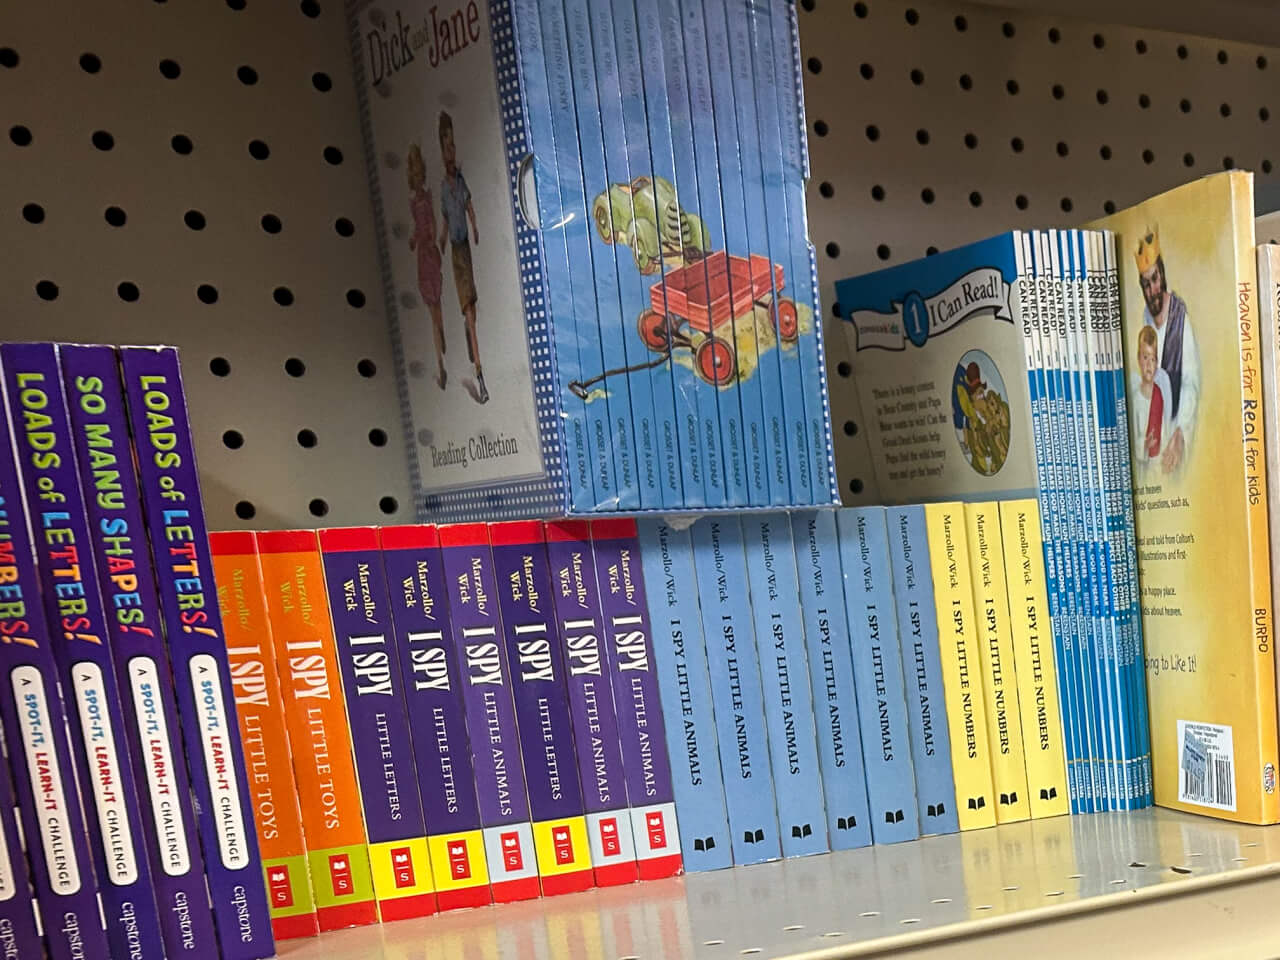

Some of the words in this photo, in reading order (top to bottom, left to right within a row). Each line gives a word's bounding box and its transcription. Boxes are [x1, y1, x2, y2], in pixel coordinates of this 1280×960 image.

[366, 12, 415, 88] Dick
[411, 28, 431, 52] and
[427, 2, 482, 70] Jane
[908, 304, 920, 335] 1
[929, 305, 938, 327] I
[939, 301, 963, 322] Can
[962, 277, 1000, 302] Read!
[1238, 282, 1251, 342] Heaven
[1241, 350, 1251, 362] is
[1242, 368, 1257, 394] for
[16, 373, 61, 469] LOADS
[1242, 399, 1259, 443] Real
[430, 444, 466, 469] Reading
[465, 437, 519, 464] Collection
[1245, 446, 1257, 471] for
[38, 477, 66, 503] of
[75, 376, 107, 415] SO
[101, 518, 154, 637] SHAPES!
[1247, 475, 1259, 505] kids
[42, 512, 102, 645] LETTERS!
[710, 522, 729, 604] Marzollo/Wick
[343, 579, 356, 612] Wick
[357, 563, 379, 624] Marzollo/
[349, 634, 386, 647] I
[723, 624, 737, 654] SPY
[1254, 608, 1269, 653] BURPO
[21, 678, 32, 686] A
[351, 651, 394, 697] SPY
[727, 657, 743, 712] LITTLE
[1161, 656, 1169, 668] to
[1171, 655, 1186, 672] Like
[24, 694, 45, 748] SPOT-IT,
[375, 712, 392, 761] LITTLE
[306, 708, 332, 775] LITTLE
[319, 783, 340, 830] TOYS
[734, 716, 752, 779] ANIMALS
[35, 753, 58, 811] LEARN-IT
[382, 763, 402, 821] LETTERS
[48, 818, 70, 888] CHALLENGE
